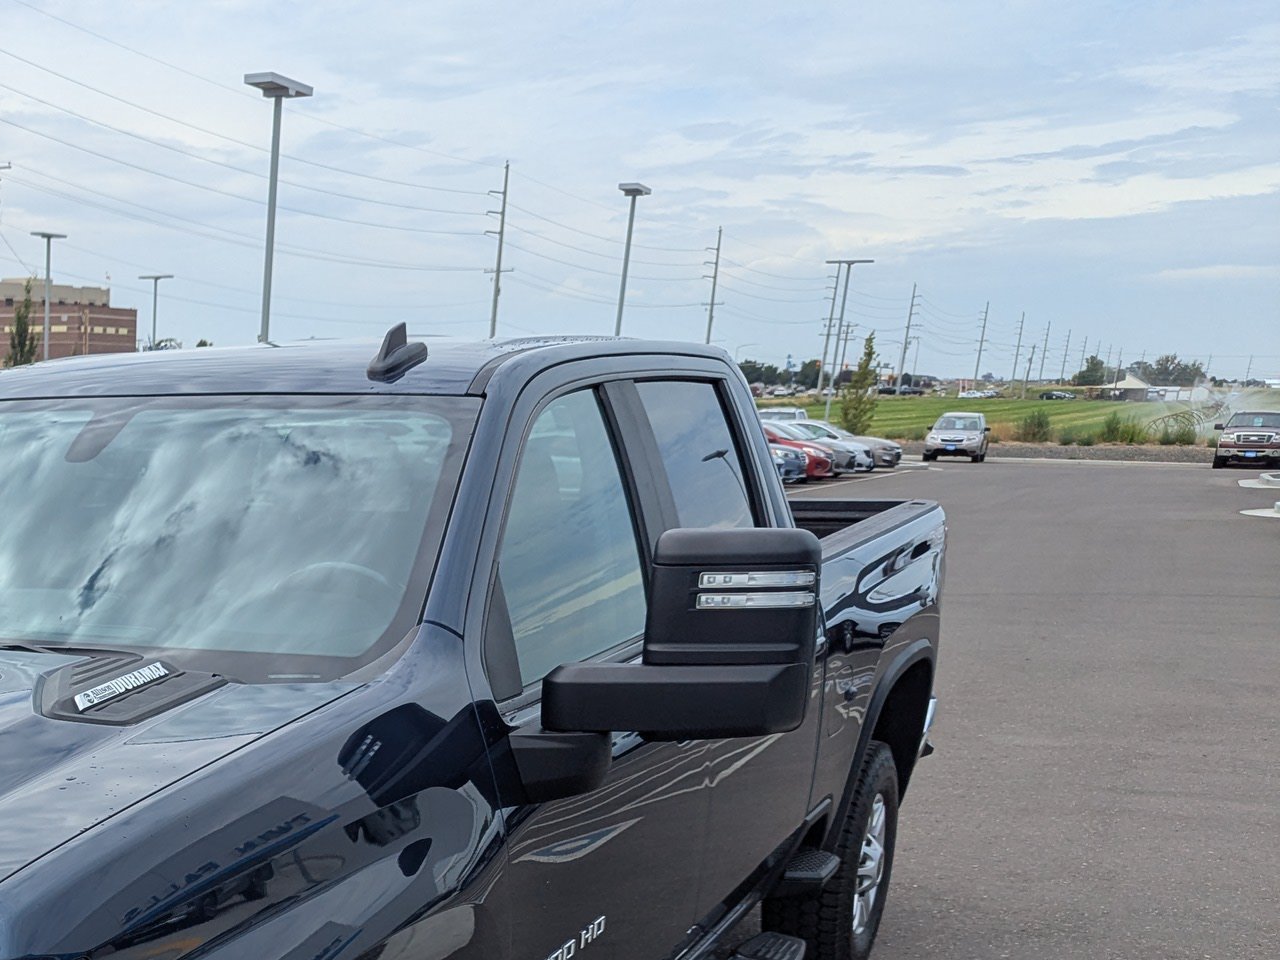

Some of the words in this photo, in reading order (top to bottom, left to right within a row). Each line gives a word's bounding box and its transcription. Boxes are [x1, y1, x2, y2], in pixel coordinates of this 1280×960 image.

[91, 684, 115, 697] Allison
[114, 662, 169, 693] DURAMAX
[579, 915, 606, 949] HD
